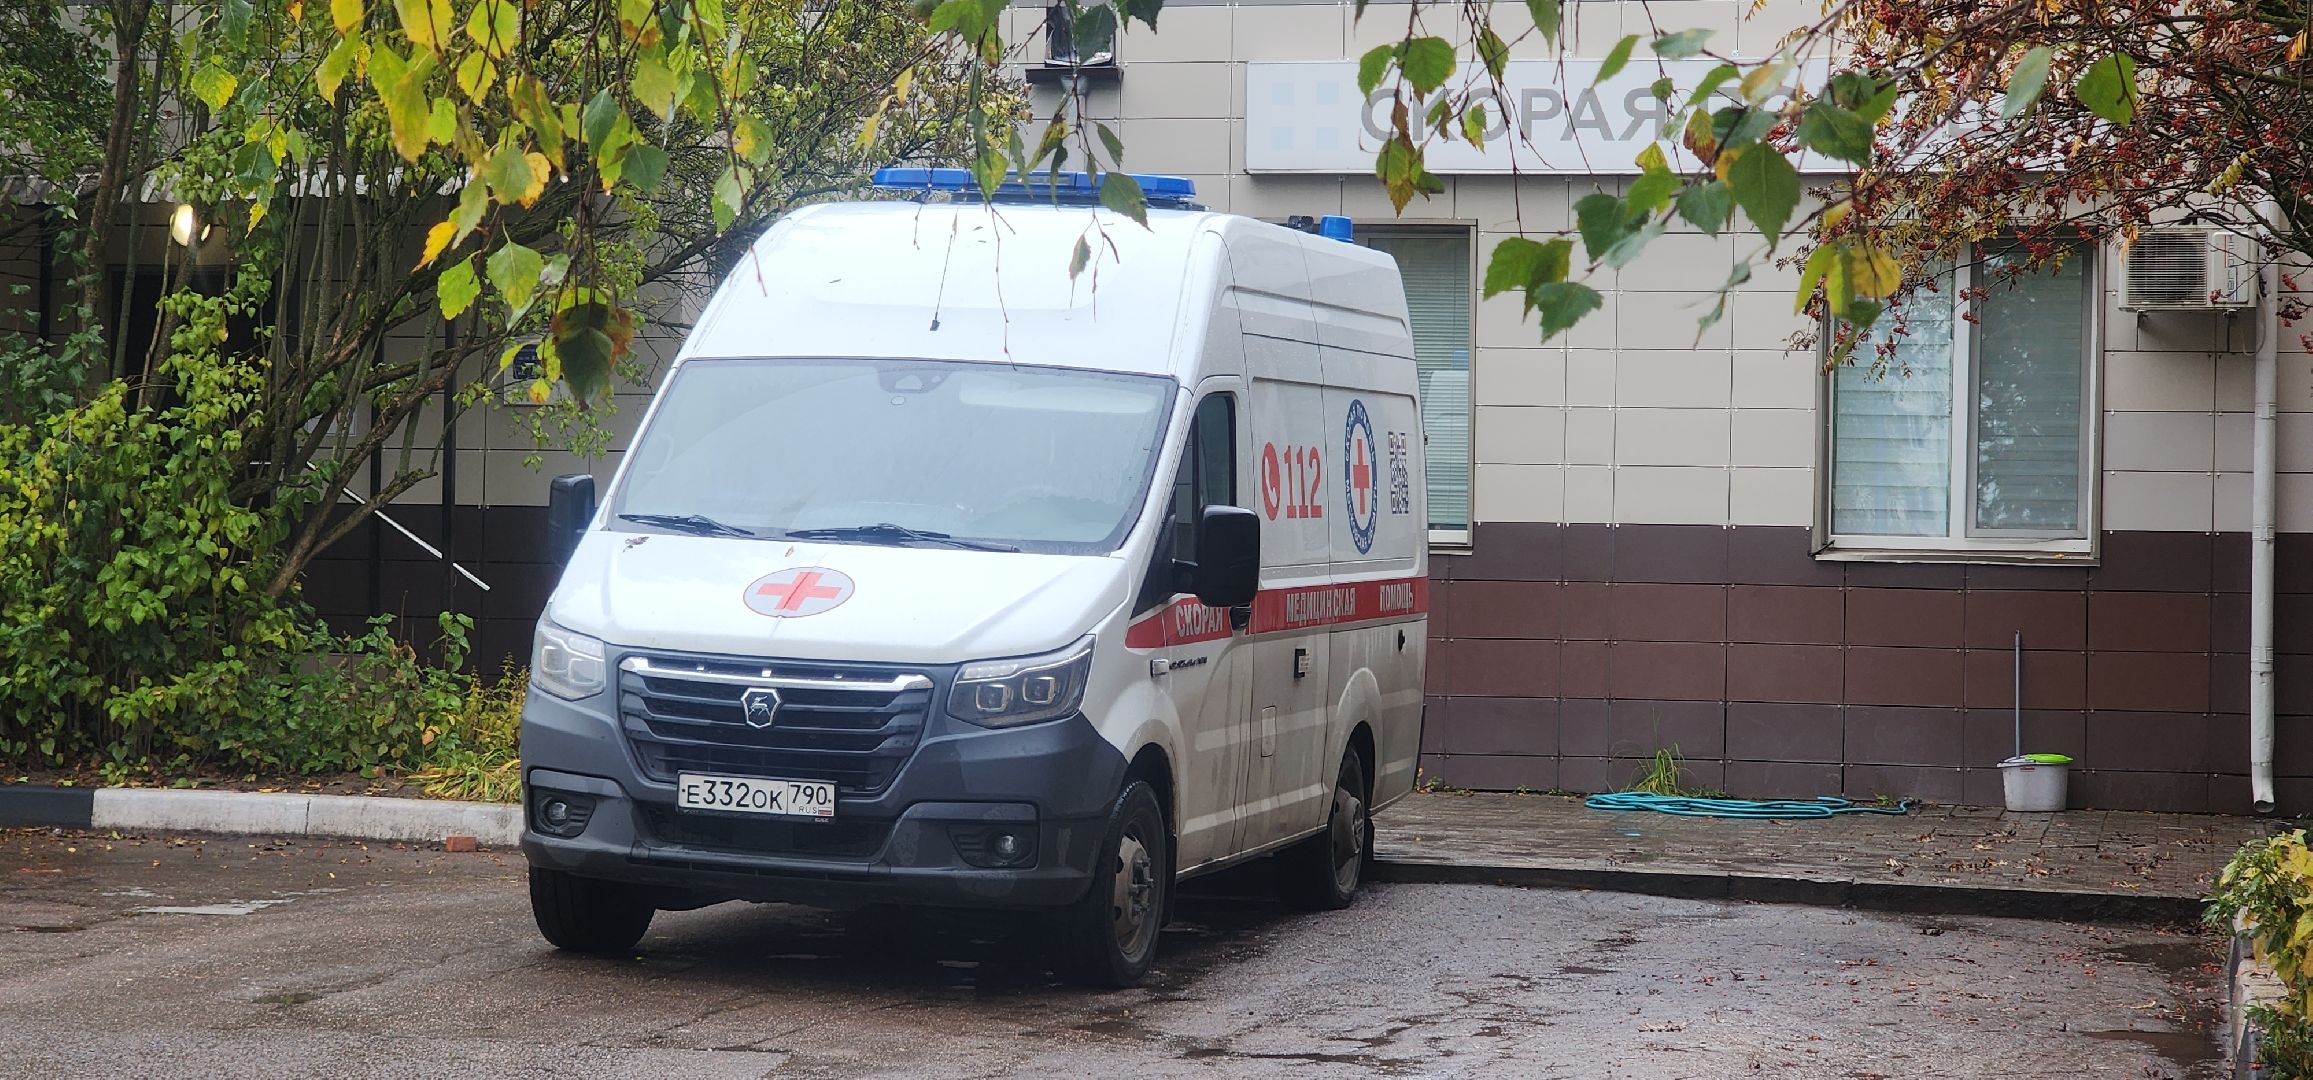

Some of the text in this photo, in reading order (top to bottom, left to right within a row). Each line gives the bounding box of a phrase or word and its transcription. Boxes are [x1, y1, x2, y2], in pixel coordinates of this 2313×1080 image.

[1284, 445, 1322, 519] 112
[1175, 583, 1414, 638] СКОРАЯ МЕДИЦИНСКАЯ ПОМОЩЬ
[790, 784, 828, 806] 790
[798, 806, 818, 814] RUS
